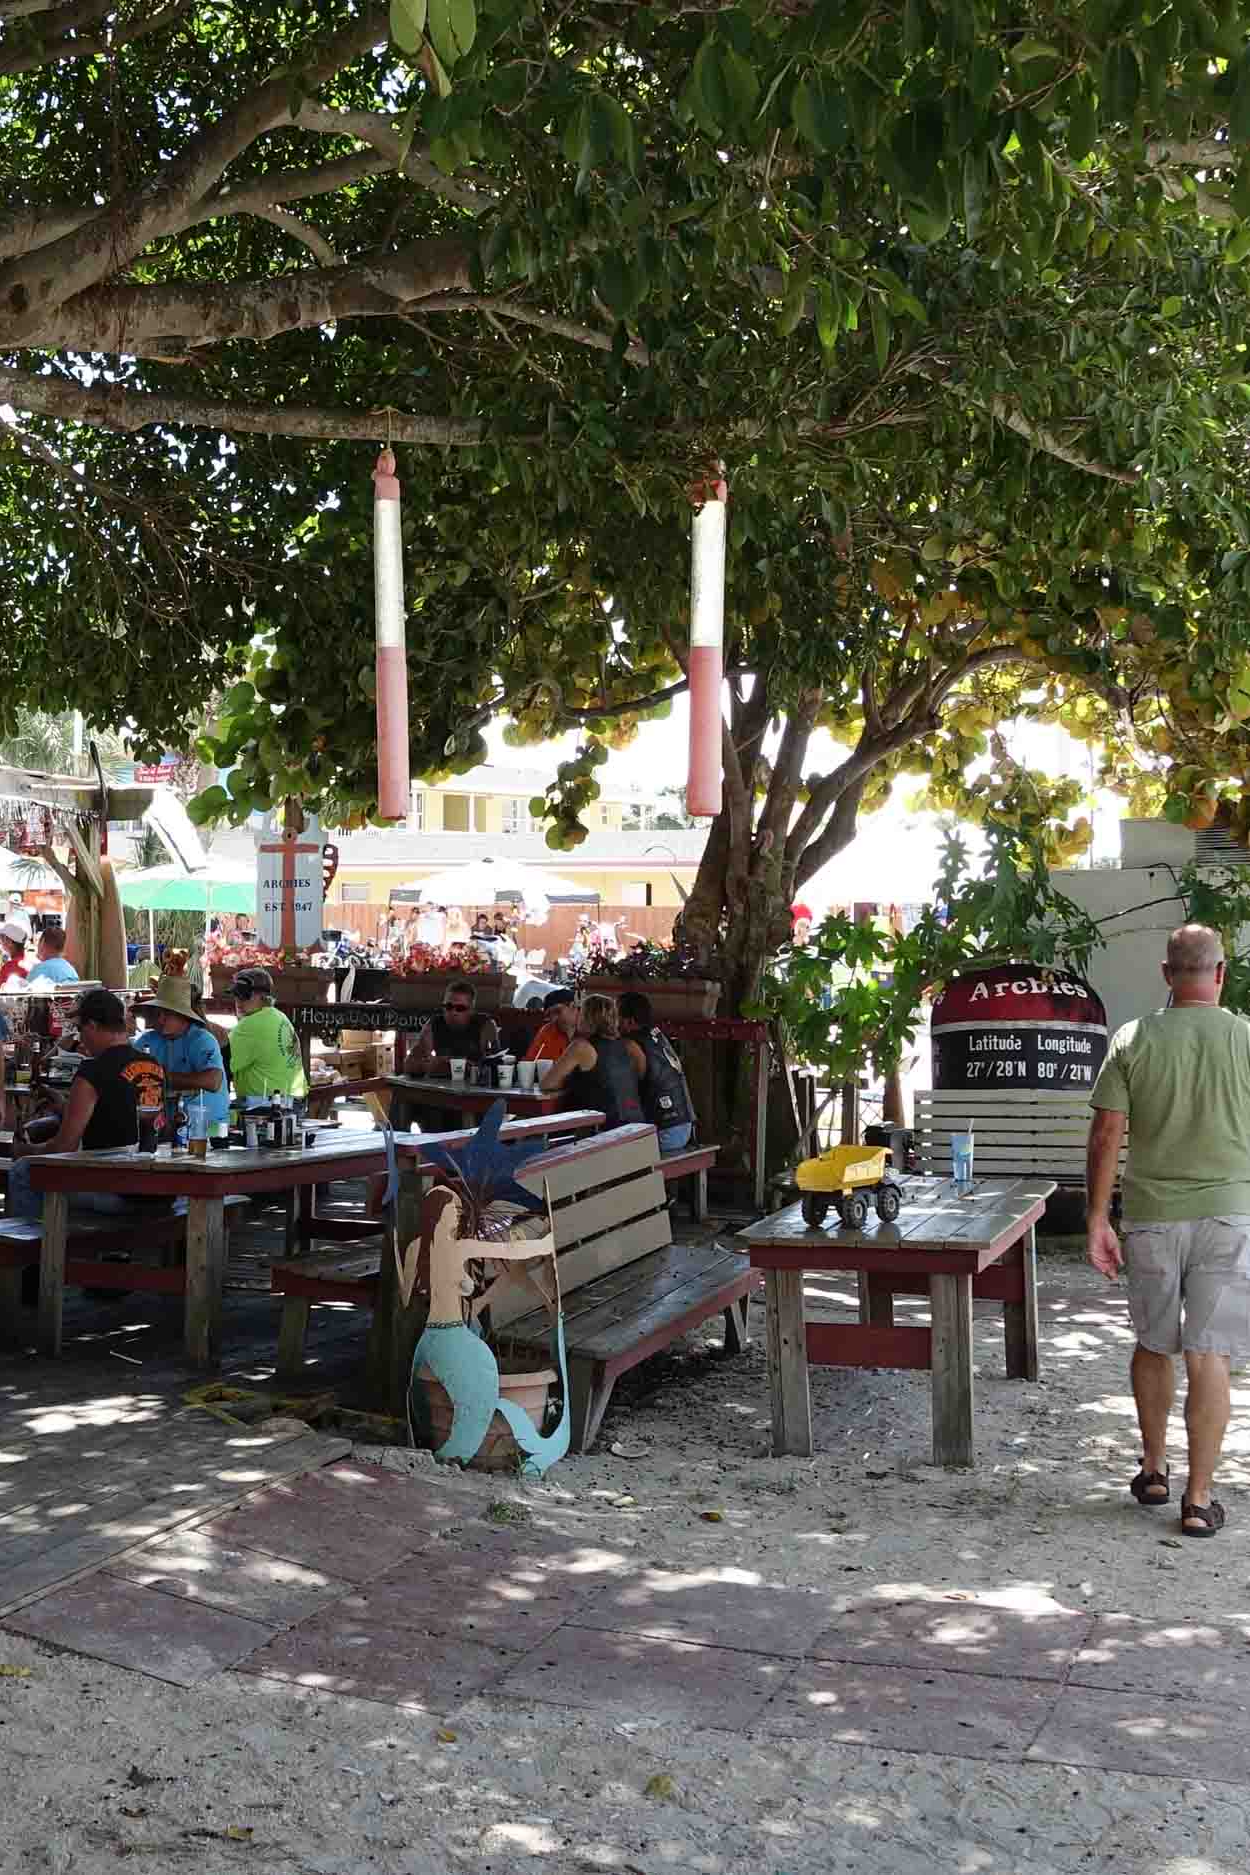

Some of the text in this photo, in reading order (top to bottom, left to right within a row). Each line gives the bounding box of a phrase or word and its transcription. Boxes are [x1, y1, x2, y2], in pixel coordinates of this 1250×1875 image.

[968, 976, 1089, 1003] Archies
[301, 1007, 344, 1027] Hope
[968, 1034, 1092, 1055] Latitude Longitude
